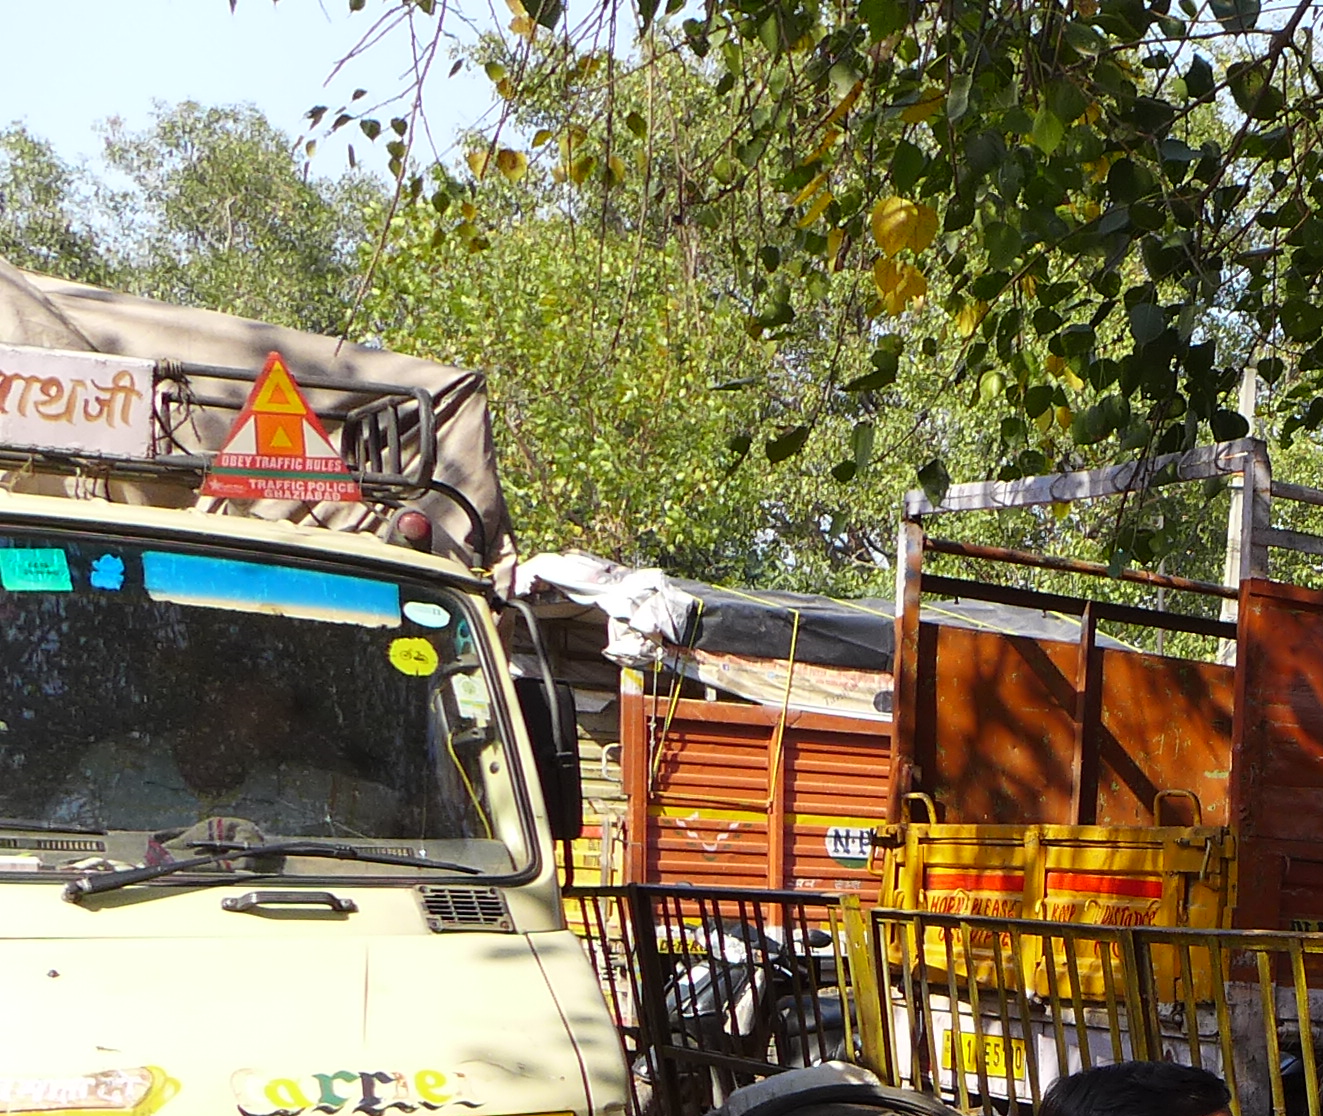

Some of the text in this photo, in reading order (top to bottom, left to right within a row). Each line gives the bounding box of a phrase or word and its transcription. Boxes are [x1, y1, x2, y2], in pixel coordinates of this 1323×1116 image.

[221, 454, 342, 472] OBEY TRAFFIC RULES
[248, 478, 306, 491] TRAFFIC
[307, 481, 356, 493] POLICE
[263, 488, 342, 501] GHAZIABAD
